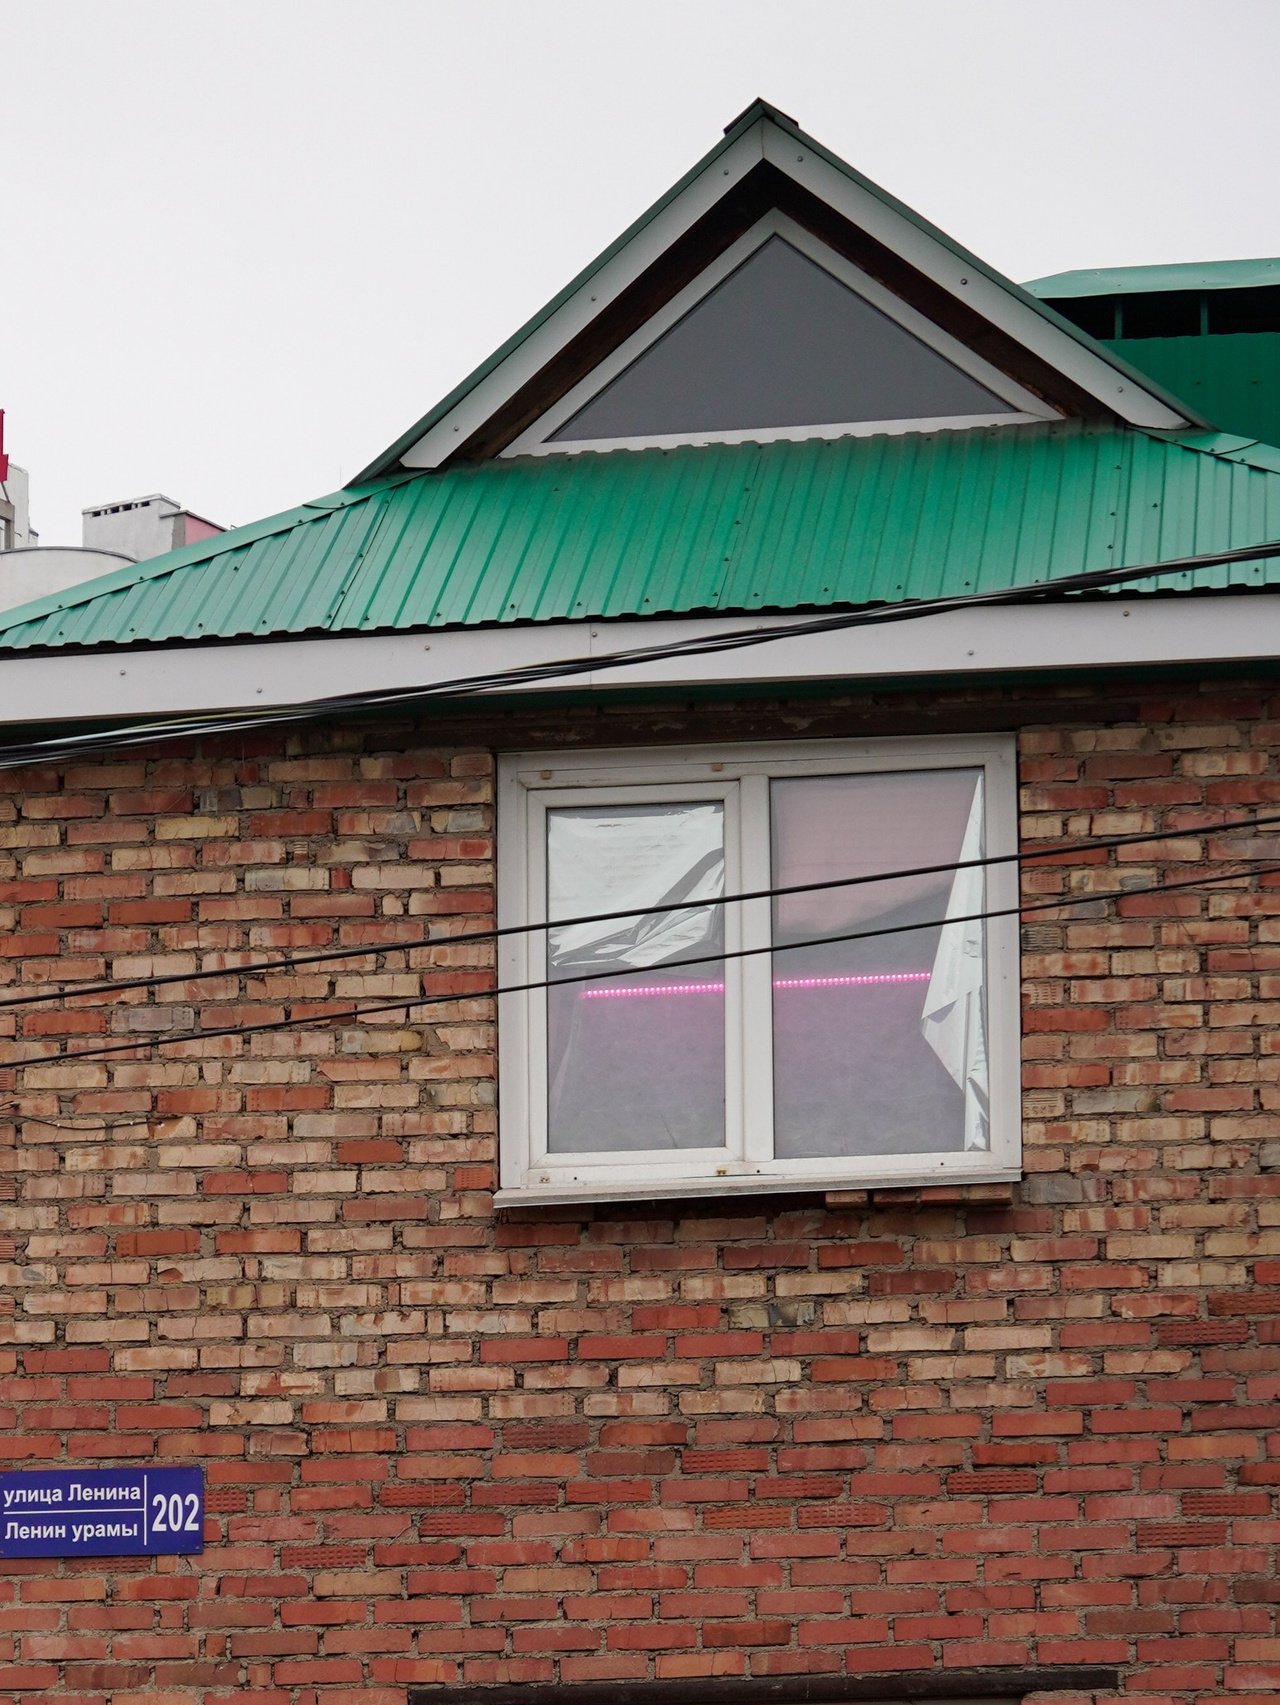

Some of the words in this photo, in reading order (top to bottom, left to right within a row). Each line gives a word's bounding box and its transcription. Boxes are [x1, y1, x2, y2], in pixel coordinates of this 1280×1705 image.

[3, 1488, 63, 1508] улица
[67, 1484, 141, 1502] Ленина
[151, 1493, 200, 1532] 202
[4, 1522, 66, 1540] Ленин
[71, 1523, 138, 1543] урамы
